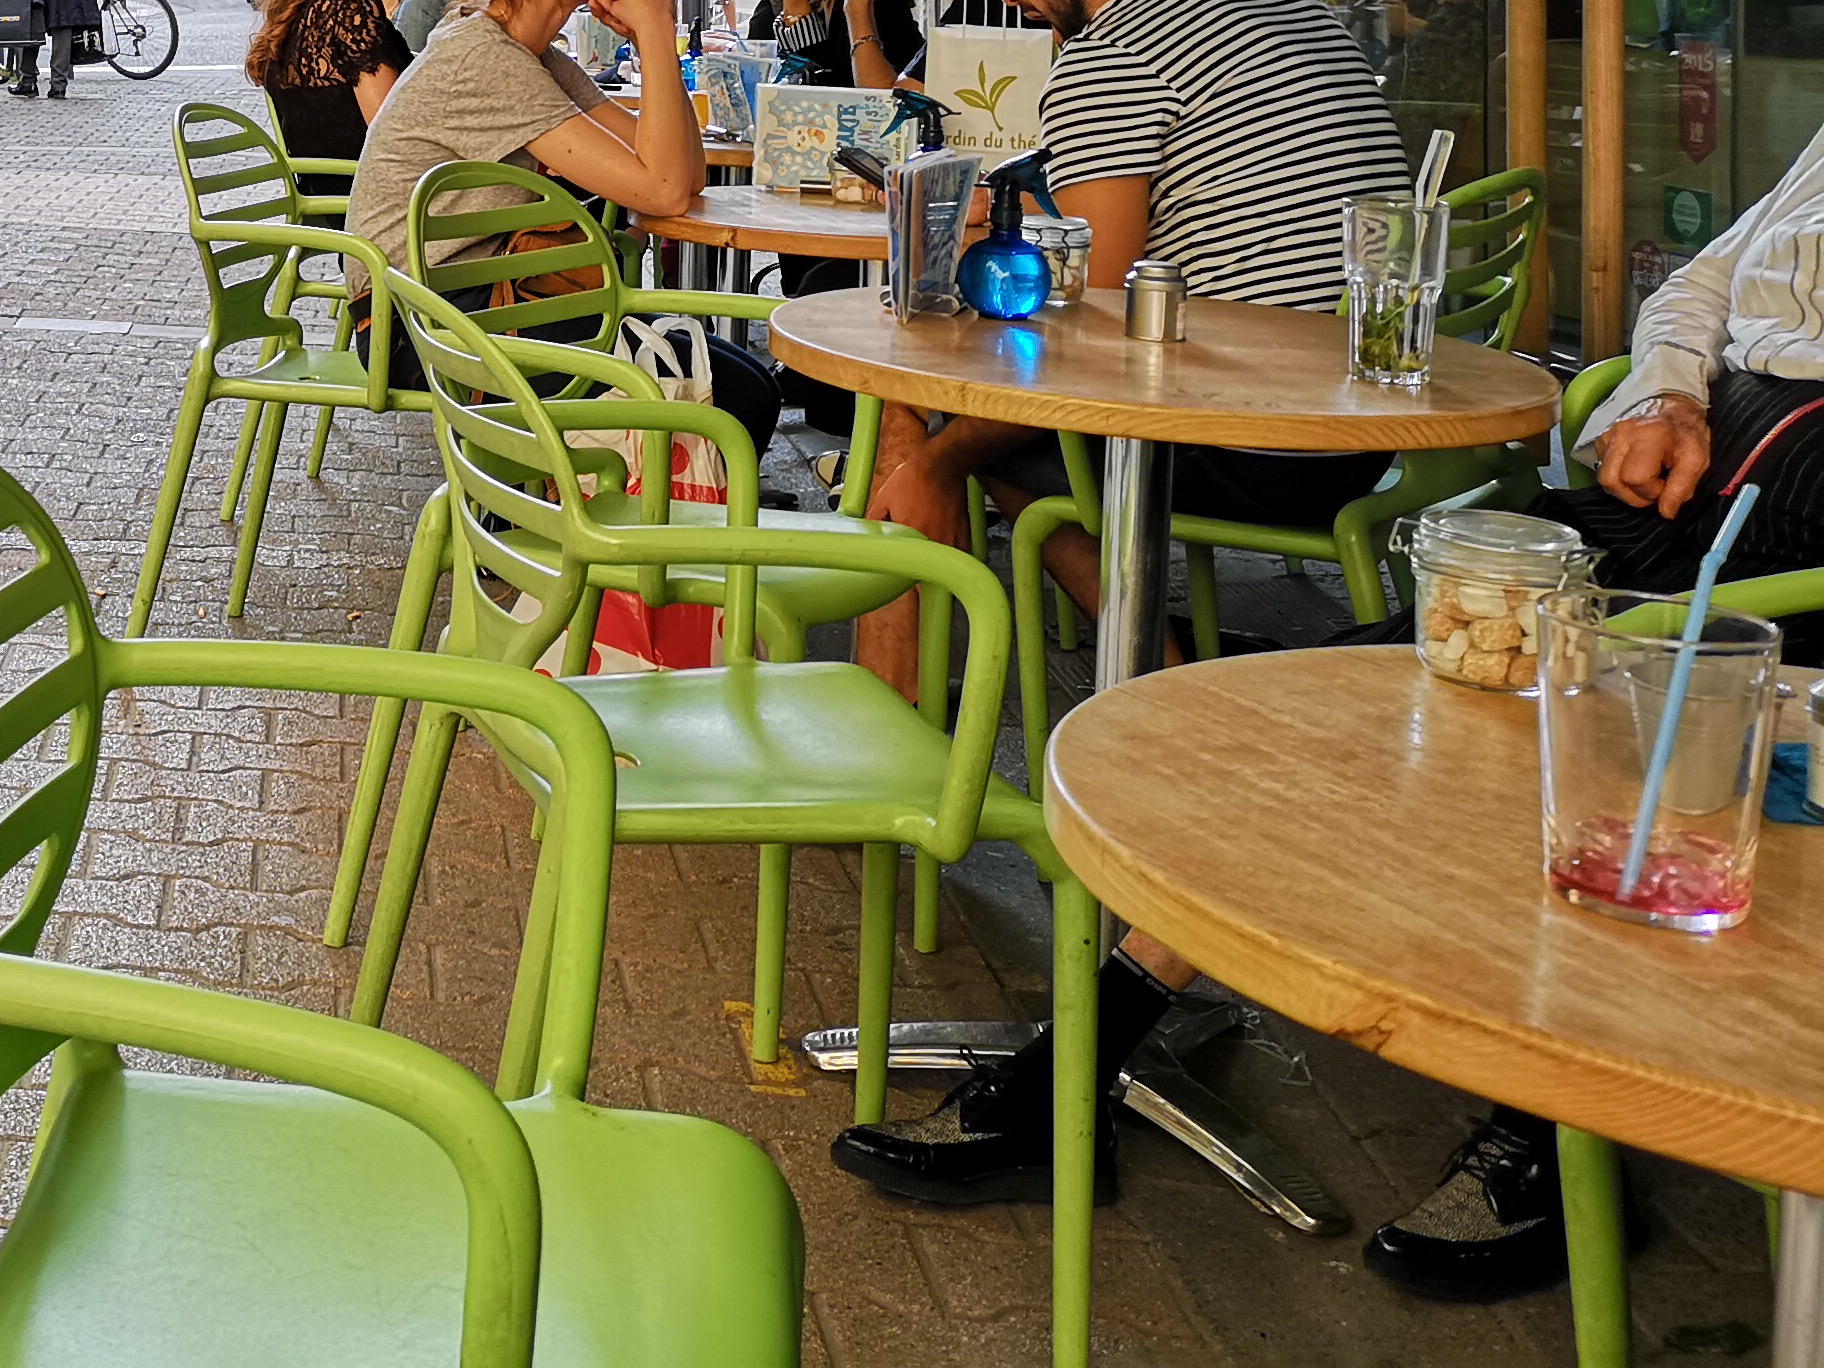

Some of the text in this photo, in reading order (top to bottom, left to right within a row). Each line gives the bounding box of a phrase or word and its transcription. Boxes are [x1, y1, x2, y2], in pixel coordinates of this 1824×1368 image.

[945, 129, 1037, 149] rdin du thé
